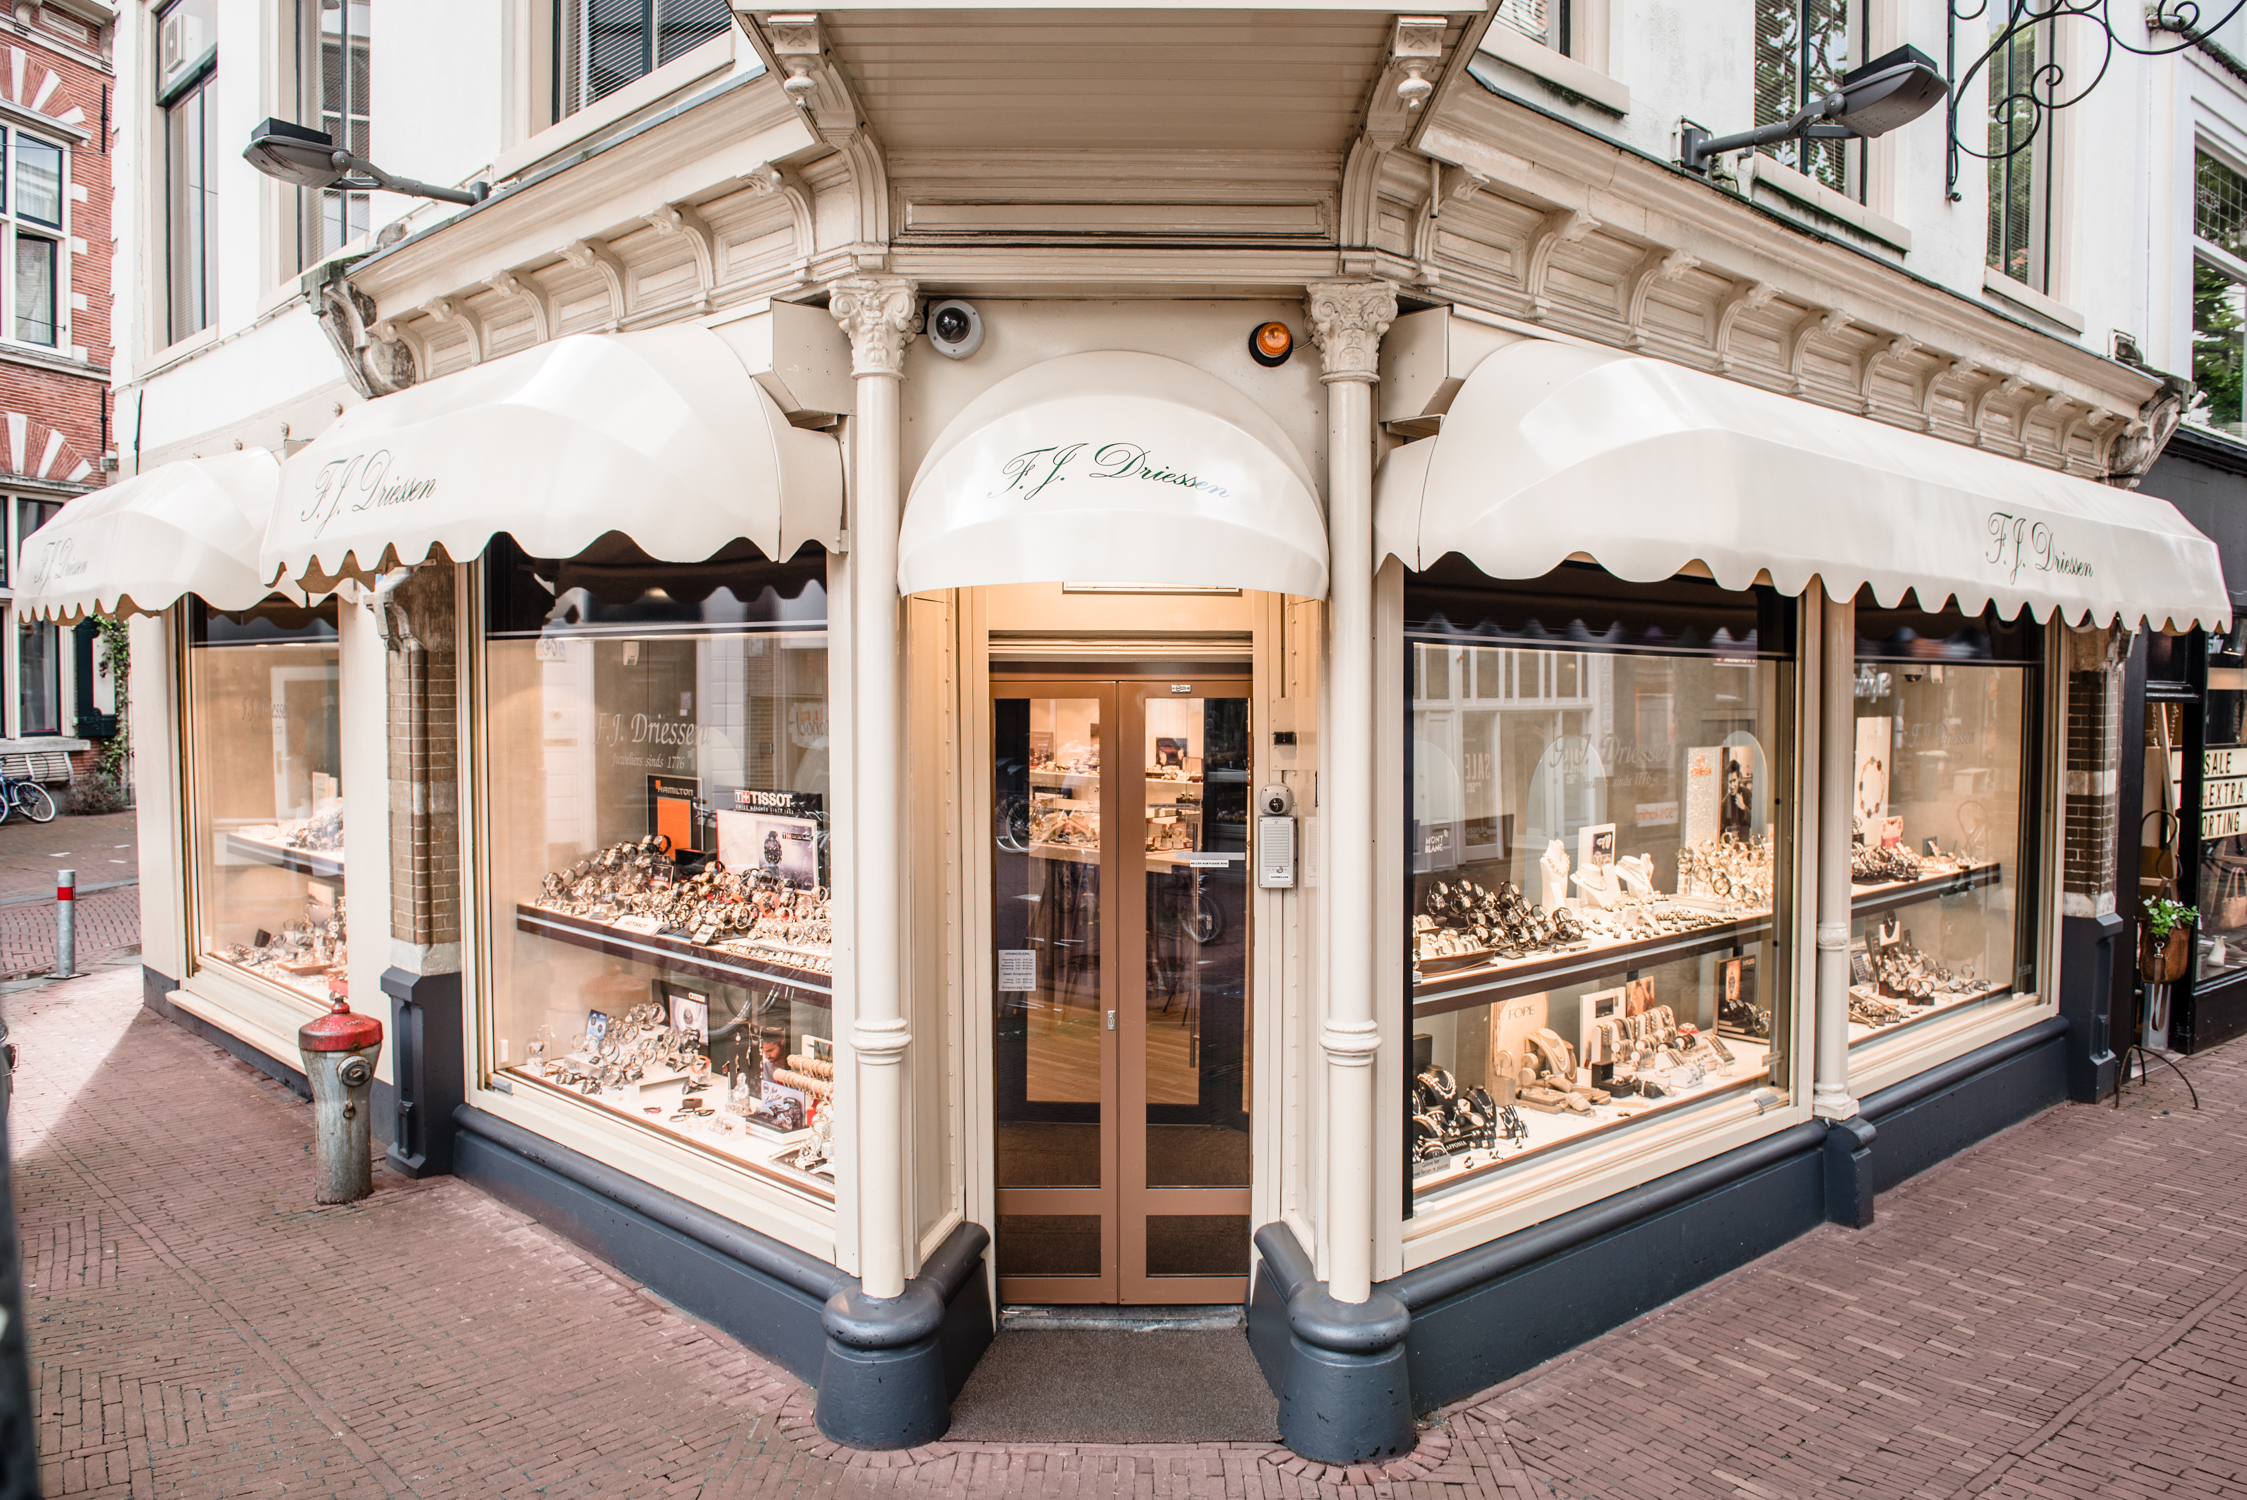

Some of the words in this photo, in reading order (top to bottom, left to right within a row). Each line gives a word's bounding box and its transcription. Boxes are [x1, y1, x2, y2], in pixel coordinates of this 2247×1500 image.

[351, 449, 437, 512] Driessen
[1089, 442, 1230, 498] Driessen
[54, 537, 88, 579] Driessen
[2031, 521, 2094, 578] Driessen
[630, 712, 711, 746] Driessen
[1598, 732, 1673, 766] Driessen
[646, 753, 664, 768] sinds
[667, 755, 686, 770] 1776
[2204, 752, 2232, 775] SALE
[657, 786, 694, 796] HAMILTON
[750, 791, 793, 808] TISSOT
[2208, 781, 2243, 806] EXTRA
[2202, 811, 2240, 837] ORTING
[1425, 835, 1444, 845] MONT
[1425, 843, 1443, 853] BLANC
[1508, 1004, 1535, 1020] FOPE
[1445, 1140, 1468, 1151] APPONIA
